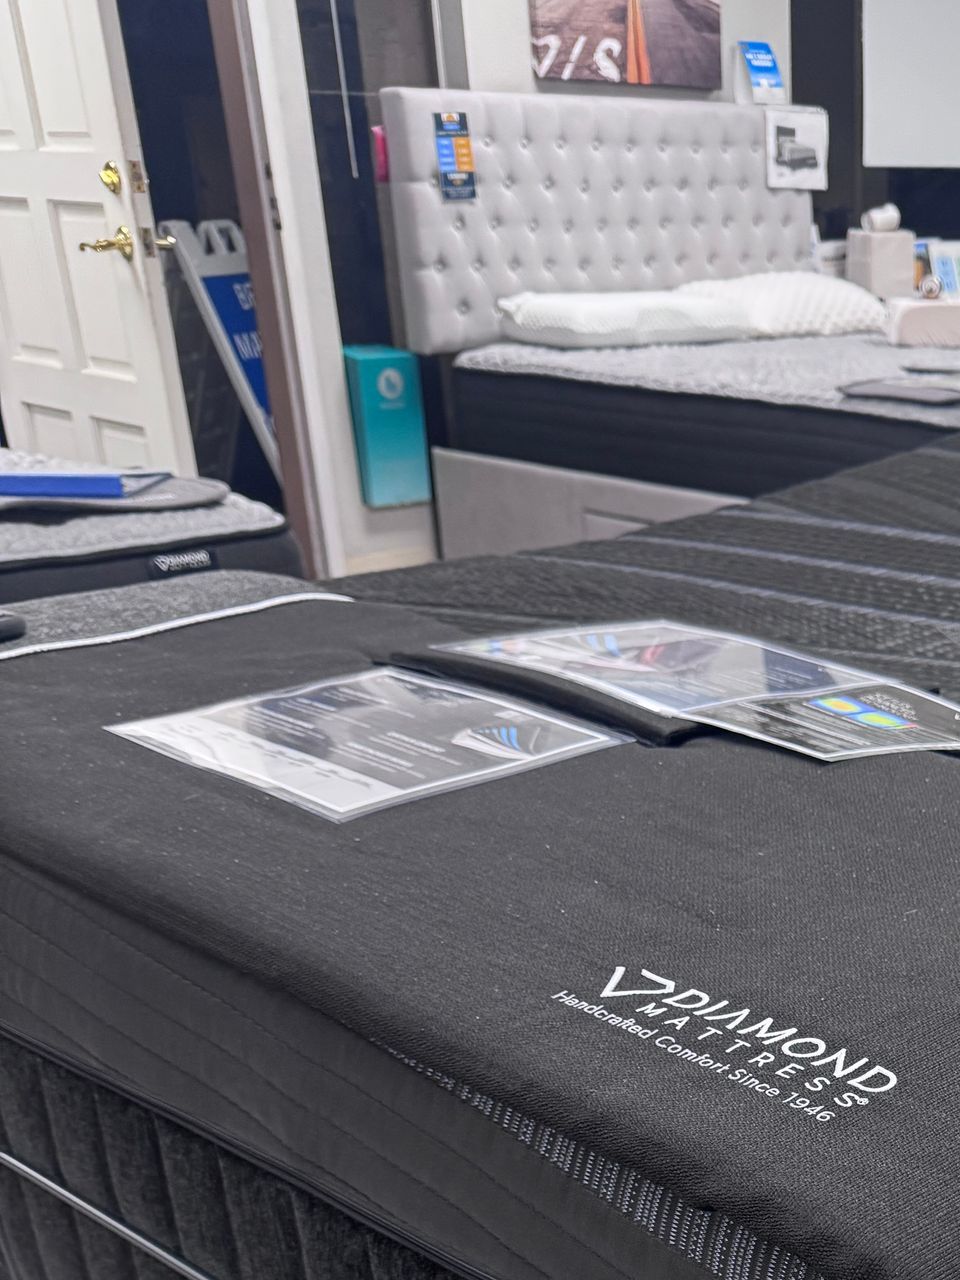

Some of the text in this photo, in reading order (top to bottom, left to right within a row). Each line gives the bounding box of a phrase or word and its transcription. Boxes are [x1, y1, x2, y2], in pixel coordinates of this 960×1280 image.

[551, 990, 836, 1122] Handcrafted Comfort Since 1946
[661, 988, 898, 1093] DIAMOND
